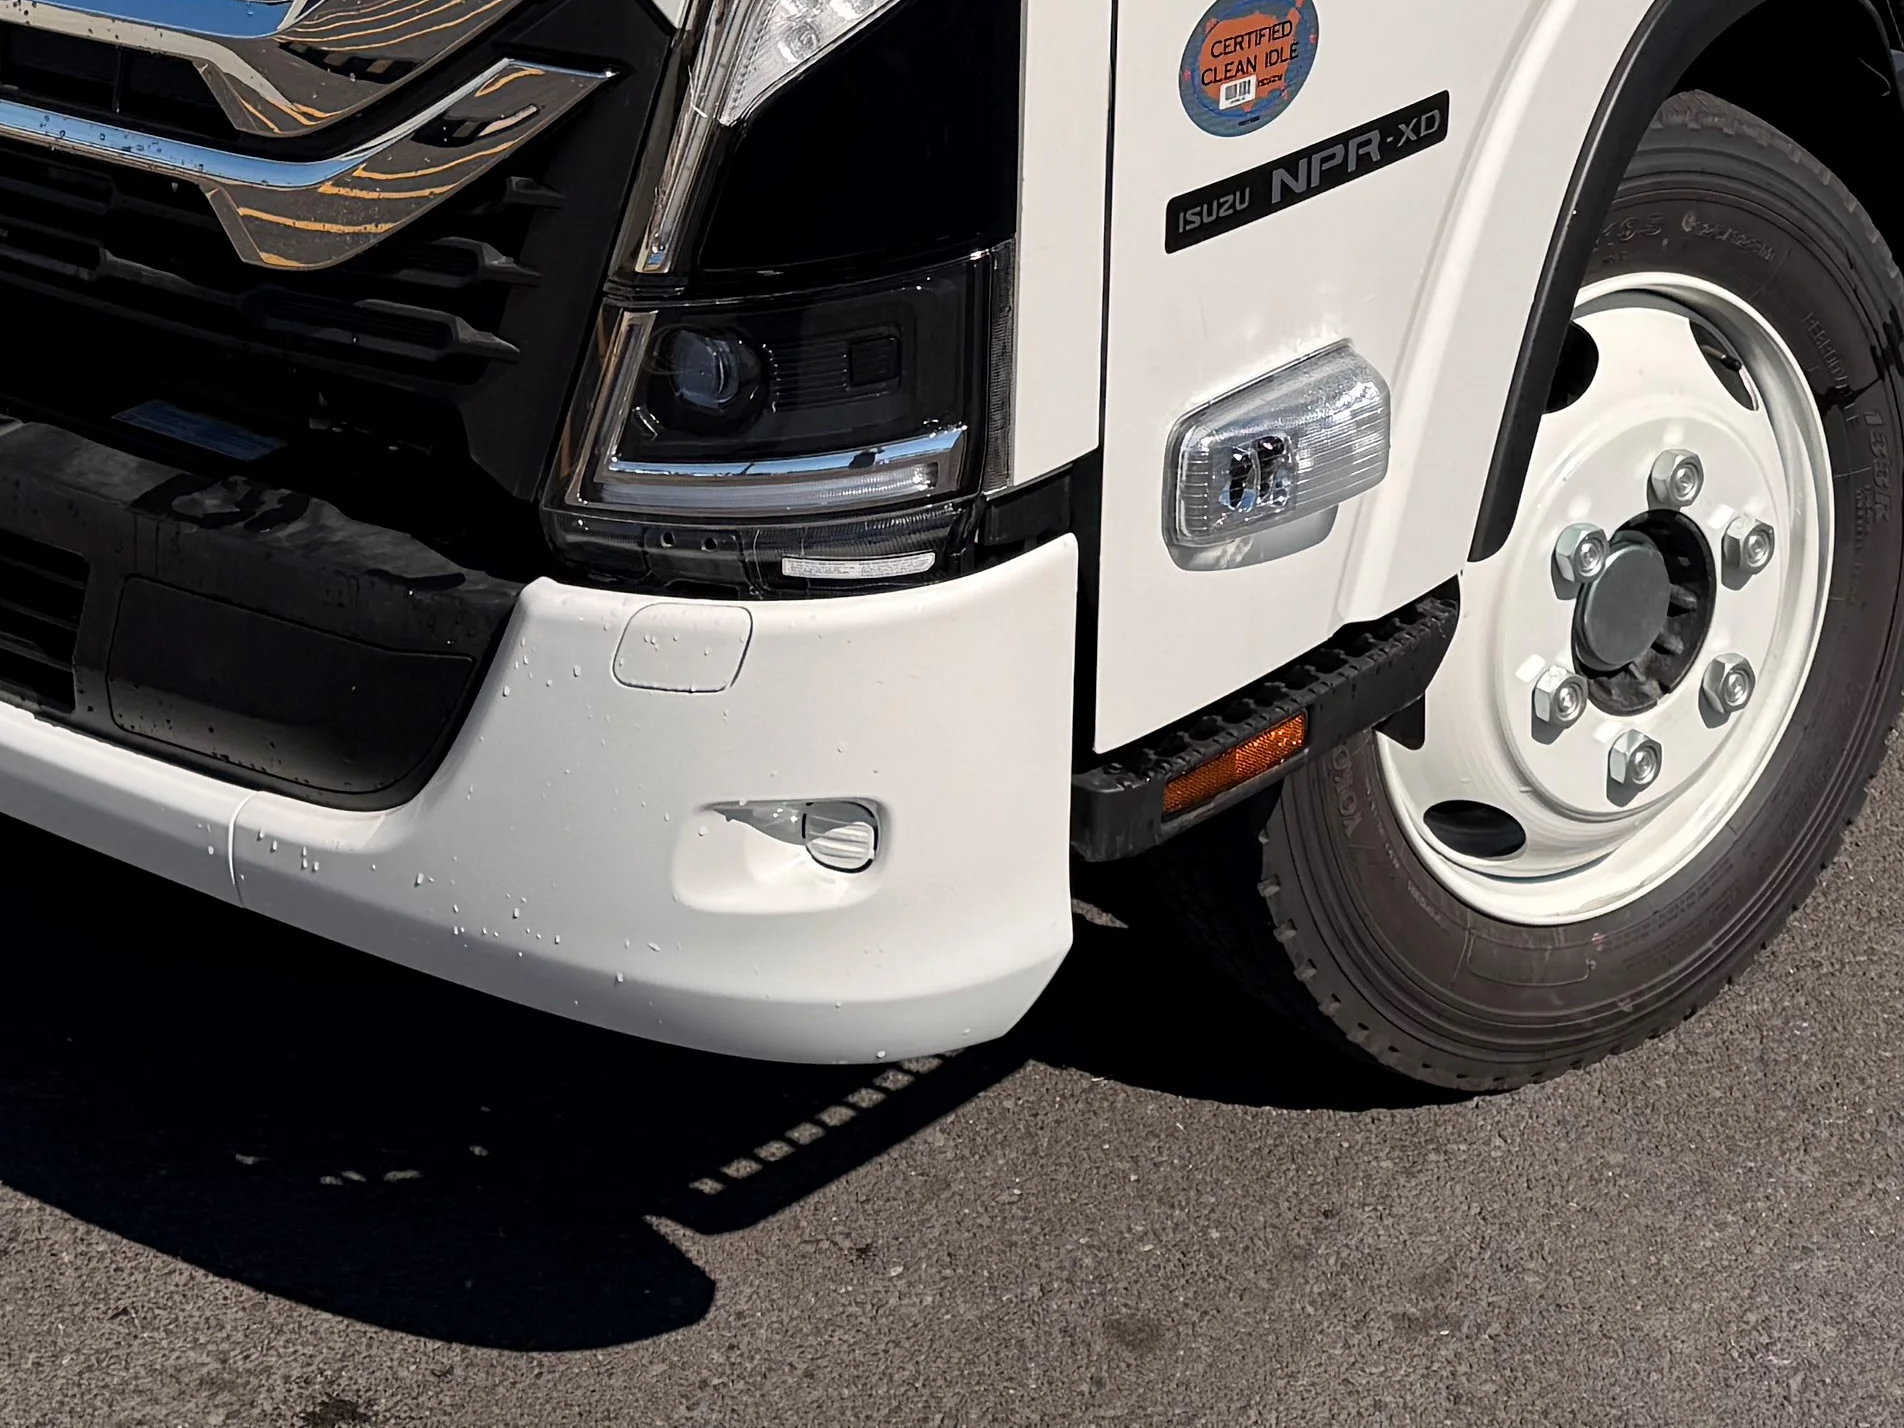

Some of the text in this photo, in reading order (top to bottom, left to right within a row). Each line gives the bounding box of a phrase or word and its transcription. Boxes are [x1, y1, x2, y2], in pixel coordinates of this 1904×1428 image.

[1211, 20, 1293, 58] CERTIFIED
[1201, 42, 1299, 86] CLEAN IDLE
[1178, 187, 1250, 233] ISUZU
